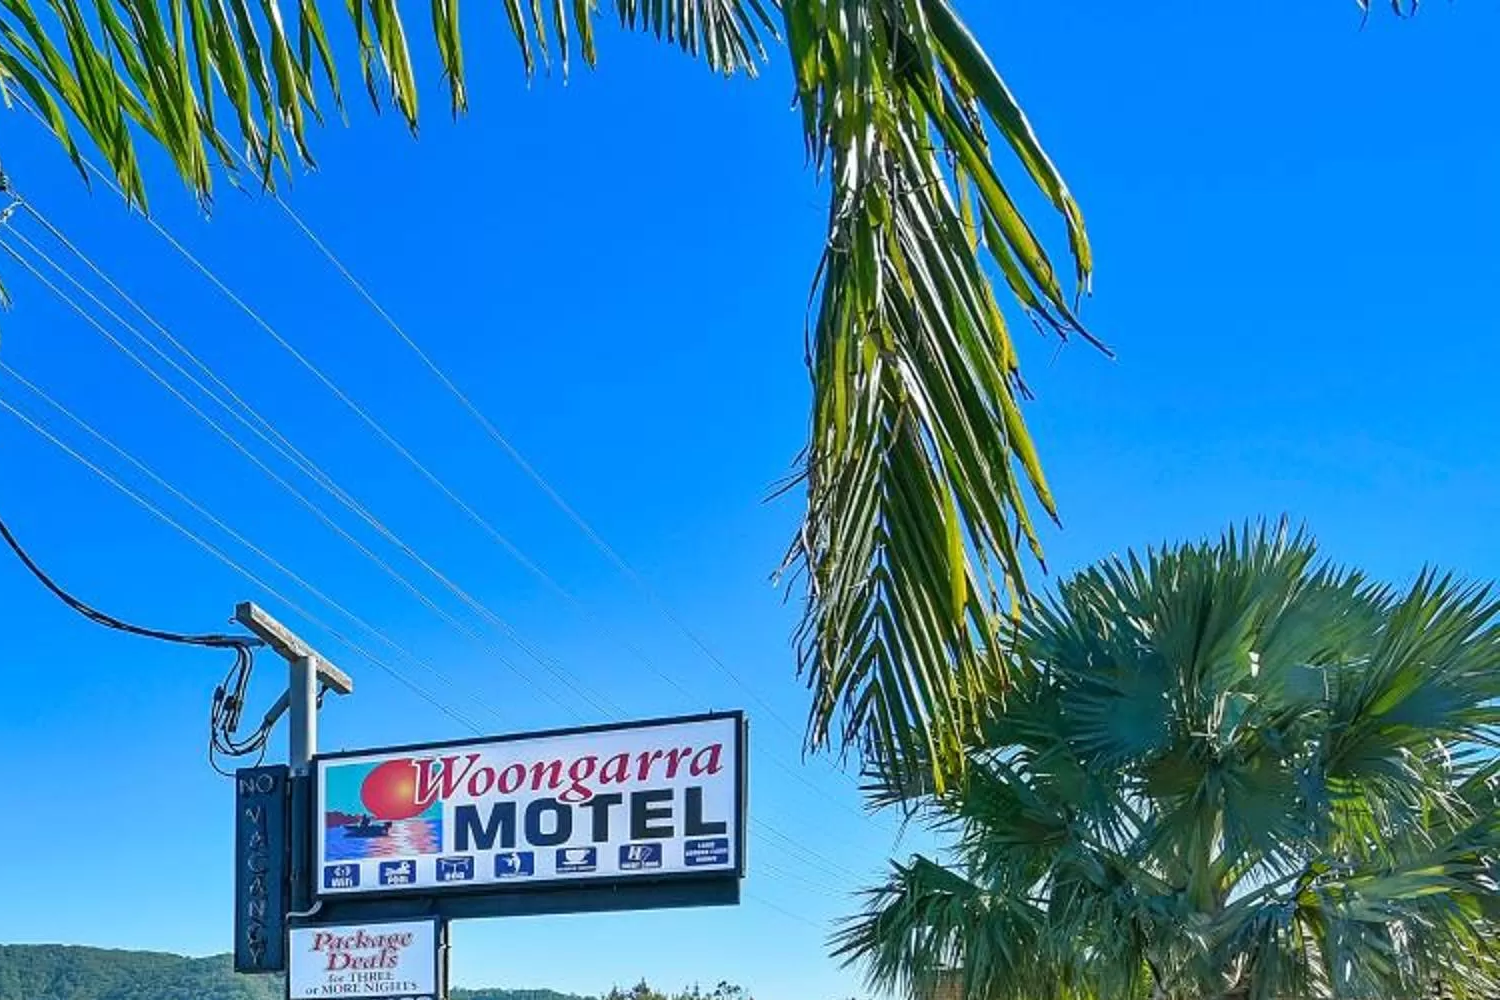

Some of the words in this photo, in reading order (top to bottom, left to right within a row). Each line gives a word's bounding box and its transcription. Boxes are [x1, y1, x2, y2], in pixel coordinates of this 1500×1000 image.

[240, 774, 273, 794] NO
[413, 743, 724, 803] Woongarra
[454, 786, 727, 851] MOTEL
[245, 805, 265, 965] VACANCY
[309, 929, 413, 952] Package
[324, 950, 398, 971] Deals
[348, 971, 395, 982] THREE
[306, 986, 317, 995] or
[322, 983, 361, 994] MORE
[364, 981, 418, 993] NIGHTS
